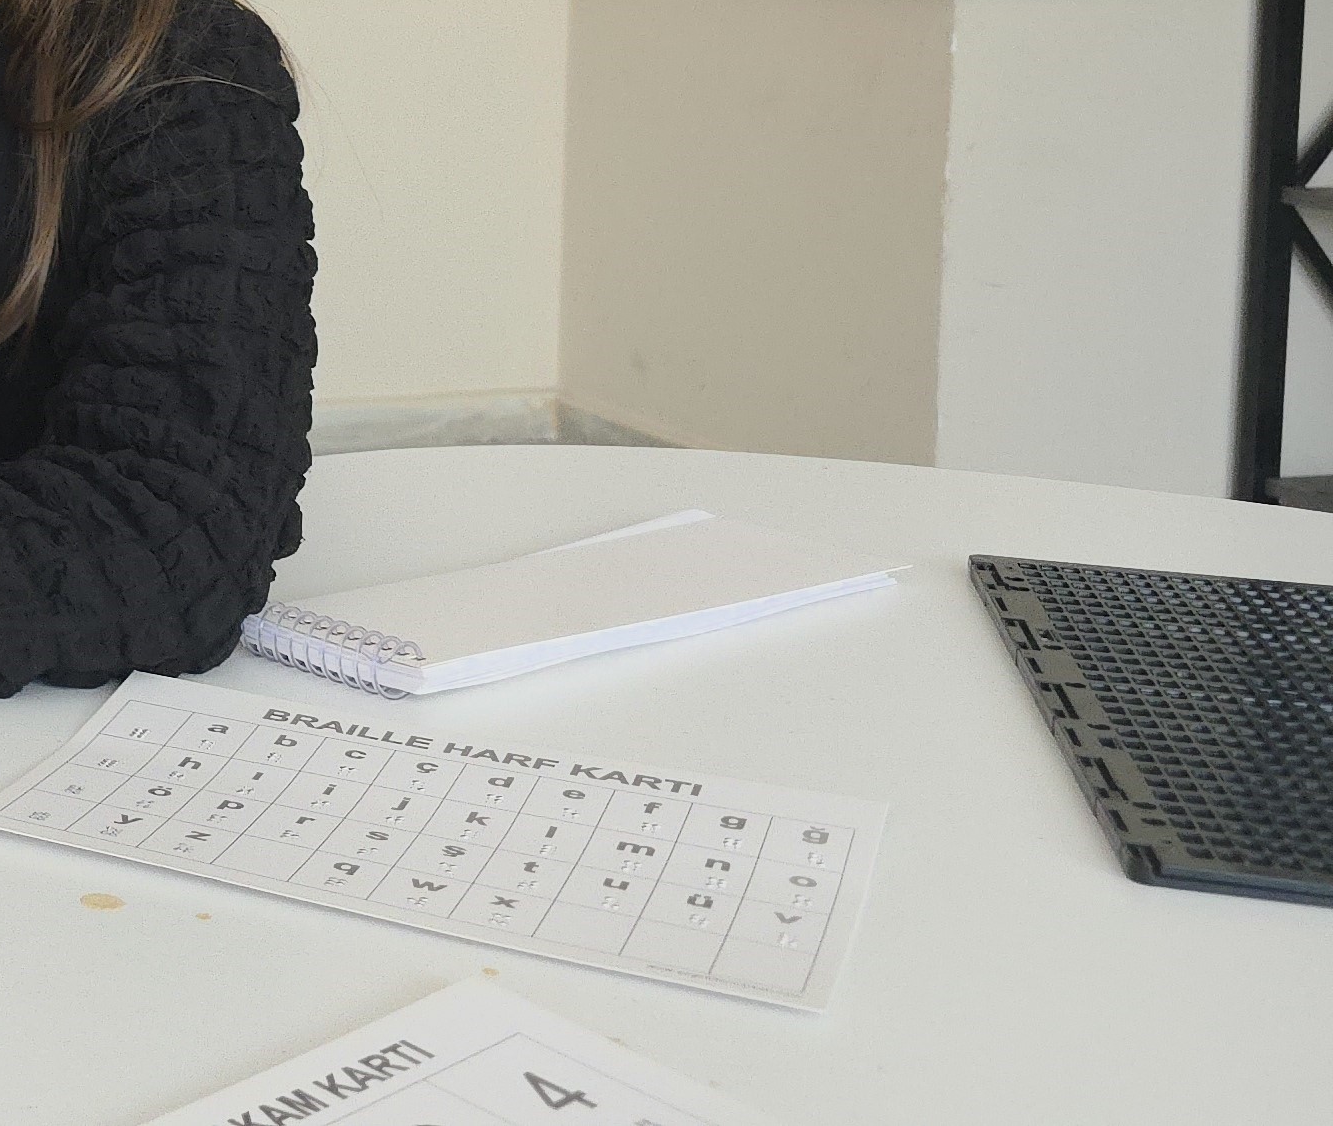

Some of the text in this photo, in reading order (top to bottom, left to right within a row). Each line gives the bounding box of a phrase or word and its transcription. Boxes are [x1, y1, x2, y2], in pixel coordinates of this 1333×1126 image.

[207, 724, 229, 735] a
[273, 734, 298, 748] b
[344, 749, 367, 760] c
[416, 762, 439, 774] ç
[487, 776, 515, 789] d
[562, 789, 586, 800] e
[643, 801, 663, 815] f
[719, 815, 748, 831] g
[262, 708, 704, 797] BRAILLE HARF KARTI
[113, 813, 518, 909] y z q w x
[147, 785, 802, 924] ö p r s ş t u ü v
[177, 756, 202, 771] h
[390, 796, 412, 811] j
[465, 811, 491, 827] k
[616, 841, 656, 857] m
[704, 858, 731, 872] n
[789, 875, 818, 888] o
[312, 1039, 436, 1100] KARTI
[522, 1070, 599, 1112] 4
